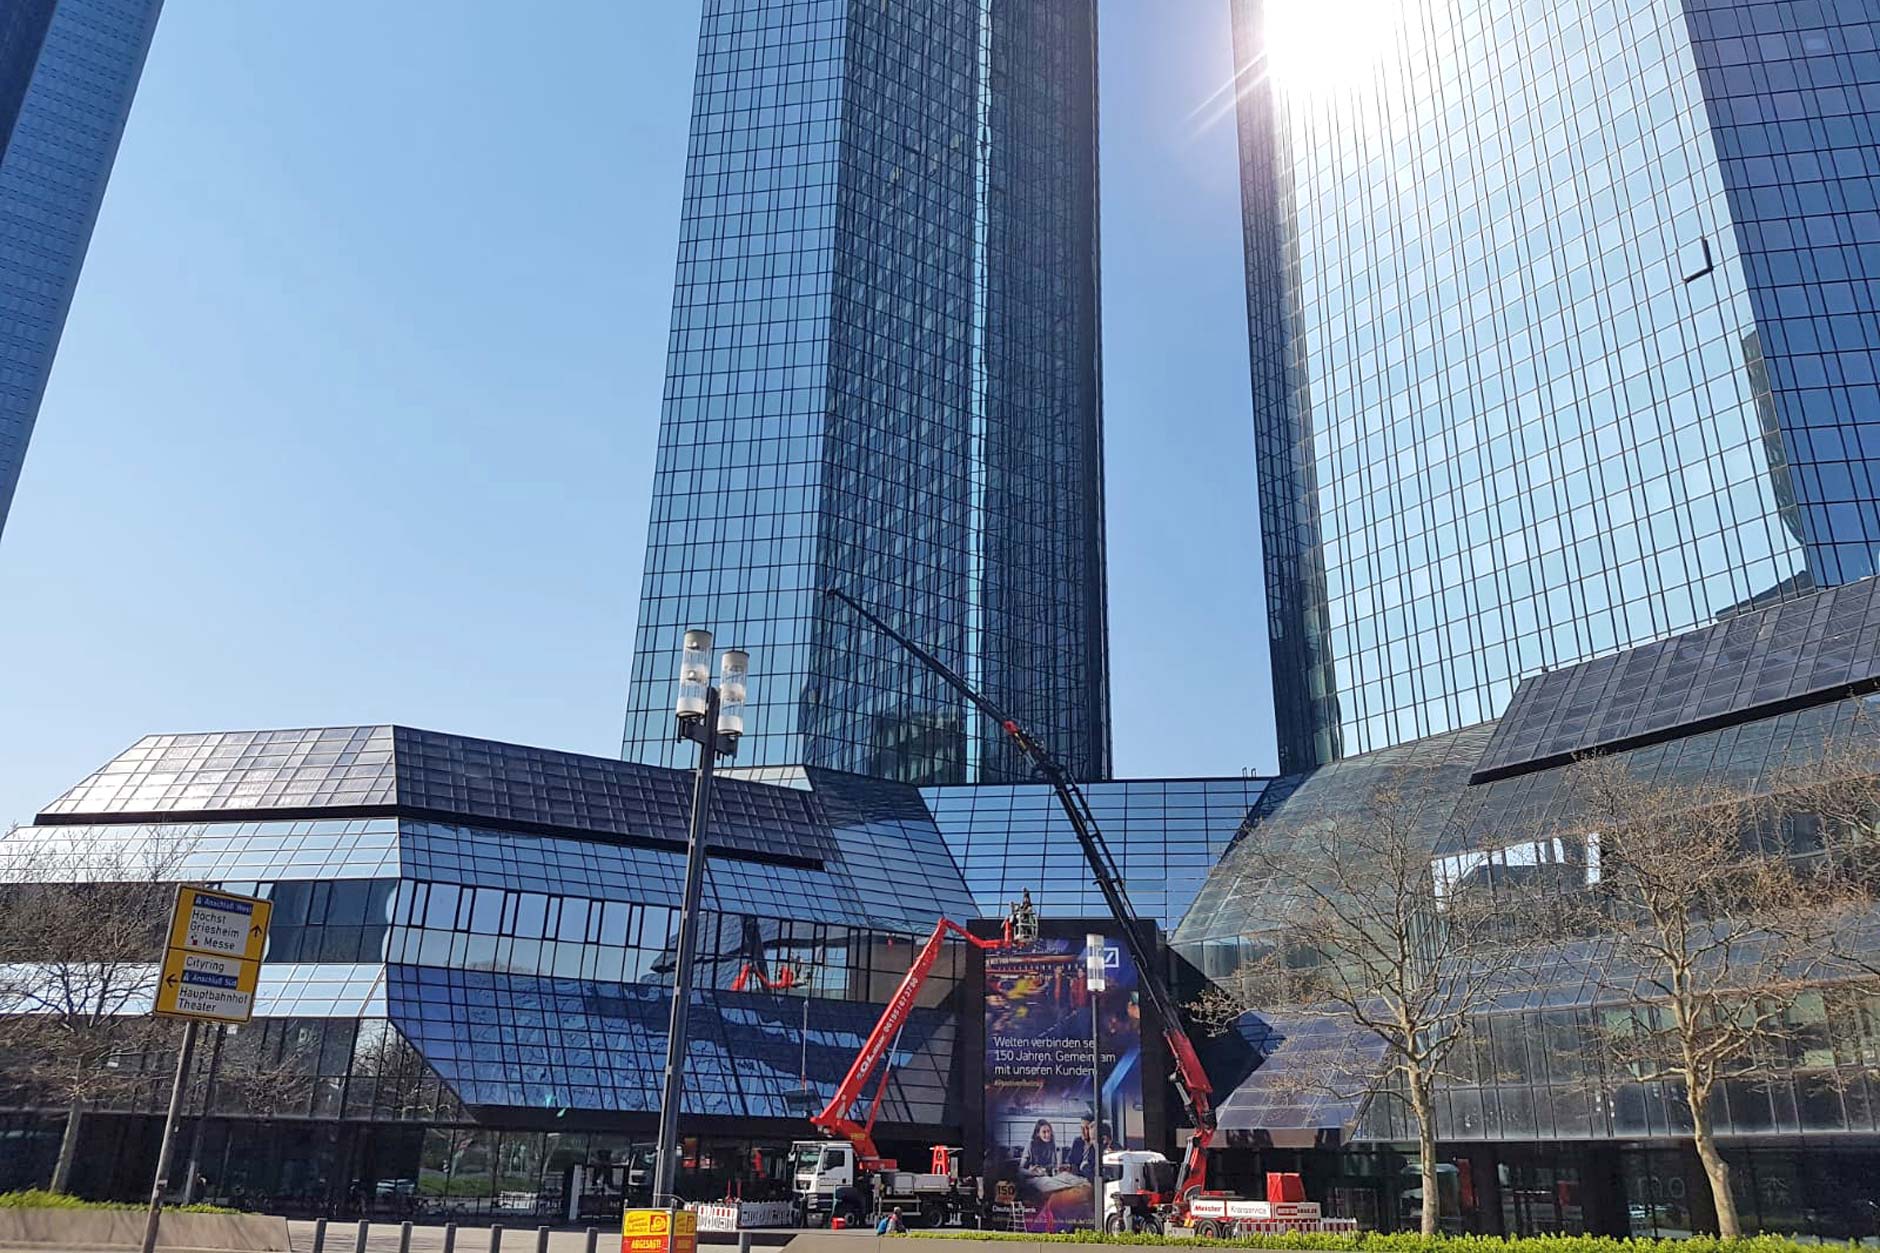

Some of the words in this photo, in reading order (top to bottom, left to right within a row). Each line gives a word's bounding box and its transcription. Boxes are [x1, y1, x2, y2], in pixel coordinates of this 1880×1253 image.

[190, 921, 240, 939] Griesheim
[203, 937, 235, 950] Messe
[186, 956, 225, 972] Cityring
[180, 986, 249, 1004] Hauptbahnhof
[179, 998, 217, 1012] Theater
[994, 1036, 1029, 1048] Welten
[1031, 1037, 1080, 1048] verbinden
[994, 1050, 1014, 1061] 150
[1055, 1051, 1116, 1063] Gemeinam
[995, 1064, 1011, 1075] mit
[1013, 1066, 1052, 1076] unseren
[997, 1185, 1016, 1195] 150
